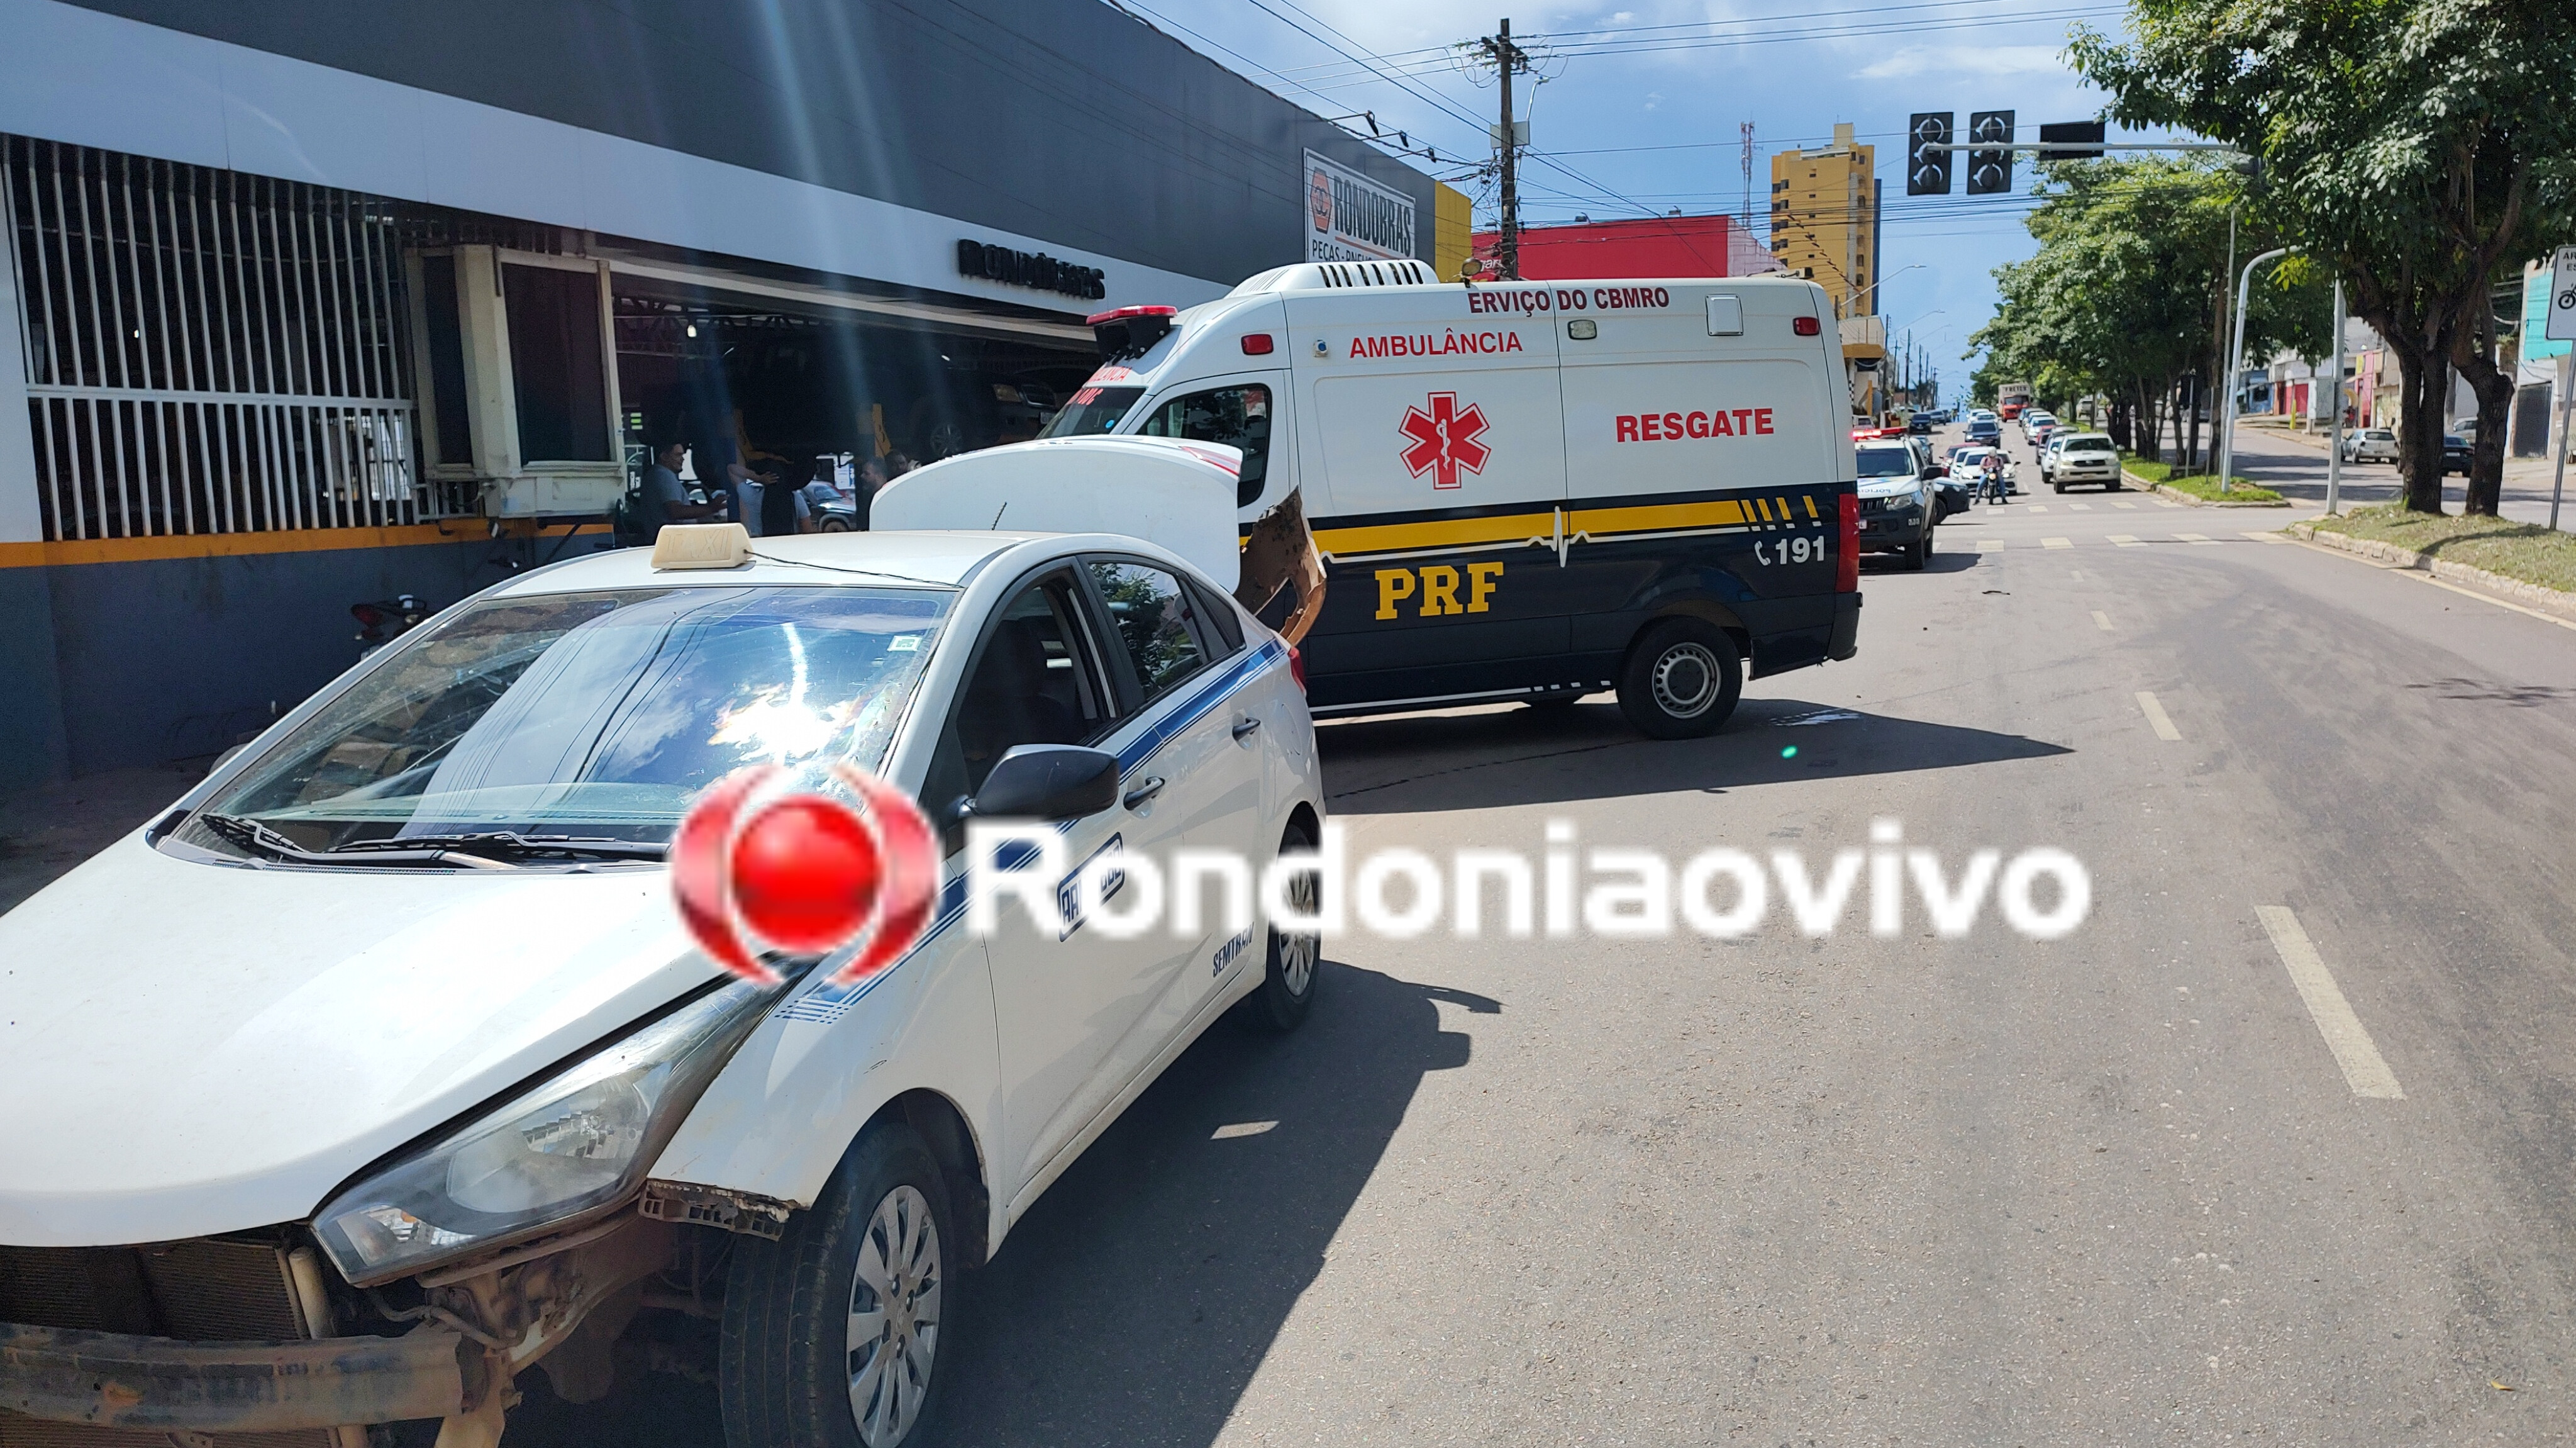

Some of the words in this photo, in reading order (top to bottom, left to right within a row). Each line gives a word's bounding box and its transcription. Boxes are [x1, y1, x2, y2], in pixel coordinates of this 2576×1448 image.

[1334, 175, 1411, 257] RONDOBRAS
[1467, 291, 1551, 318] ERVIÇO
[1557, 289, 1587, 311] DO
[1594, 287, 1670, 309] CBMRO
[1350, 327, 1523, 359] AMBULÂNCIA
[1616, 408, 1774, 443] RESGATE
[1775, 535, 1824, 565] 191
[1375, 561, 1504, 620] PRF
[1213, 921, 1255, 978] SEMTRAN
